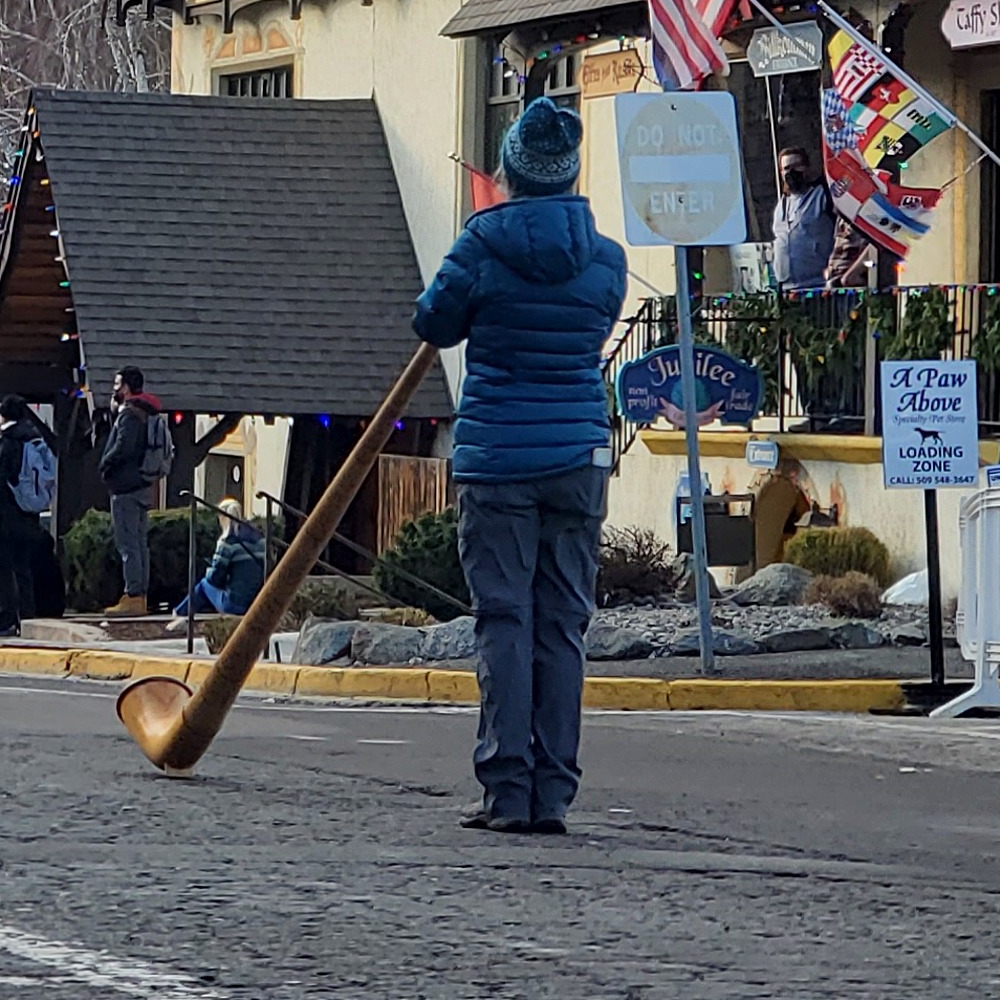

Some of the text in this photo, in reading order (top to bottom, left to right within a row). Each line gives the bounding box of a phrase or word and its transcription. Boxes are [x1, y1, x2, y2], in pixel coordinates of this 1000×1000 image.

[956, 3, 984, 34] Taffy
[636, 124, 717, 147] DO NOT
[650, 191, 715, 215] ENTER
[648, 352, 736, 387] Juilee
[890, 366, 968, 388] A Paw
[897, 389, 962, 412] Above
[899, 446, 963, 459] LOADING
[913, 461, 951, 473] ZONE
[916, 476, 933, 484] 509
